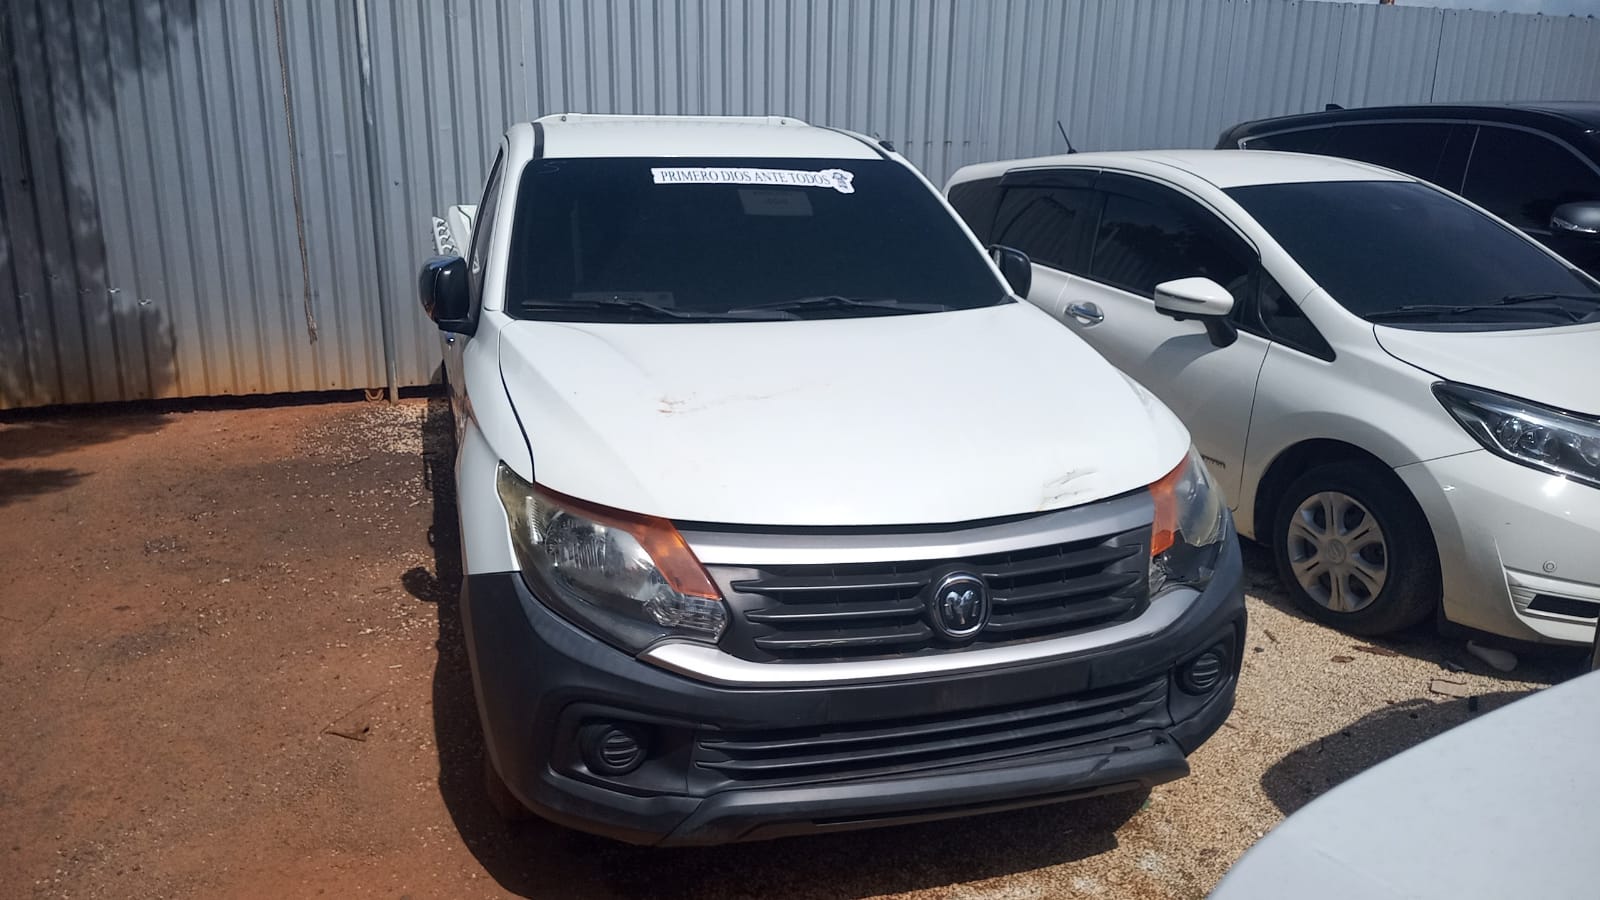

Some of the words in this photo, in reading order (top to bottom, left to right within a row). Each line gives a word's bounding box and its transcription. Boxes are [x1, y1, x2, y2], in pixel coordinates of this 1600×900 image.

[660, 170, 719, 182] PRIMERO
[722, 170, 752, 182] DIOS
[755, 171, 788, 183] ANTE
[789, 172, 831, 186] TODOS
